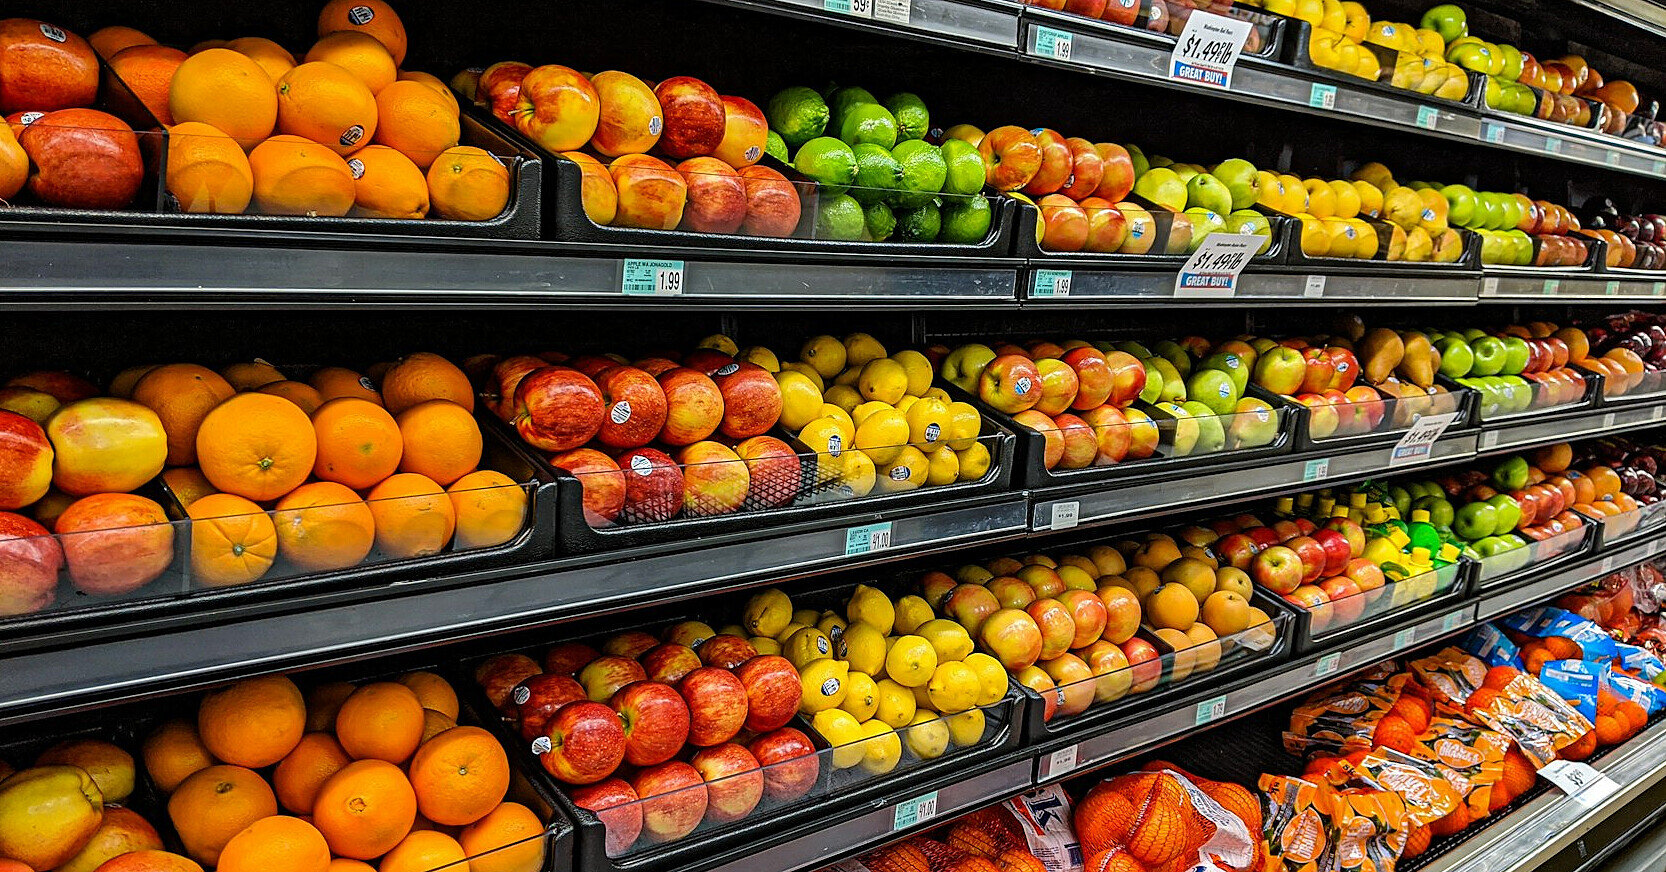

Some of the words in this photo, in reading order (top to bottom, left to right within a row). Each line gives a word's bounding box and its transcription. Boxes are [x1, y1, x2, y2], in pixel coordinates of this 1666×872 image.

[1057, 41, 1070, 58] 1.99
[1183, 33, 1220, 62] $1.49
[1179, 65, 1203, 80] GREAT
[1205, 71, 1223, 84] BUY!
[1193, 251, 1231, 270] $1.49
[661, 271, 680, 290] 1.99
[1057, 279, 1069, 294] 1.99
[1186, 275, 1209, 287] GREAT
[1211, 276, 1229, 287] BUY!
